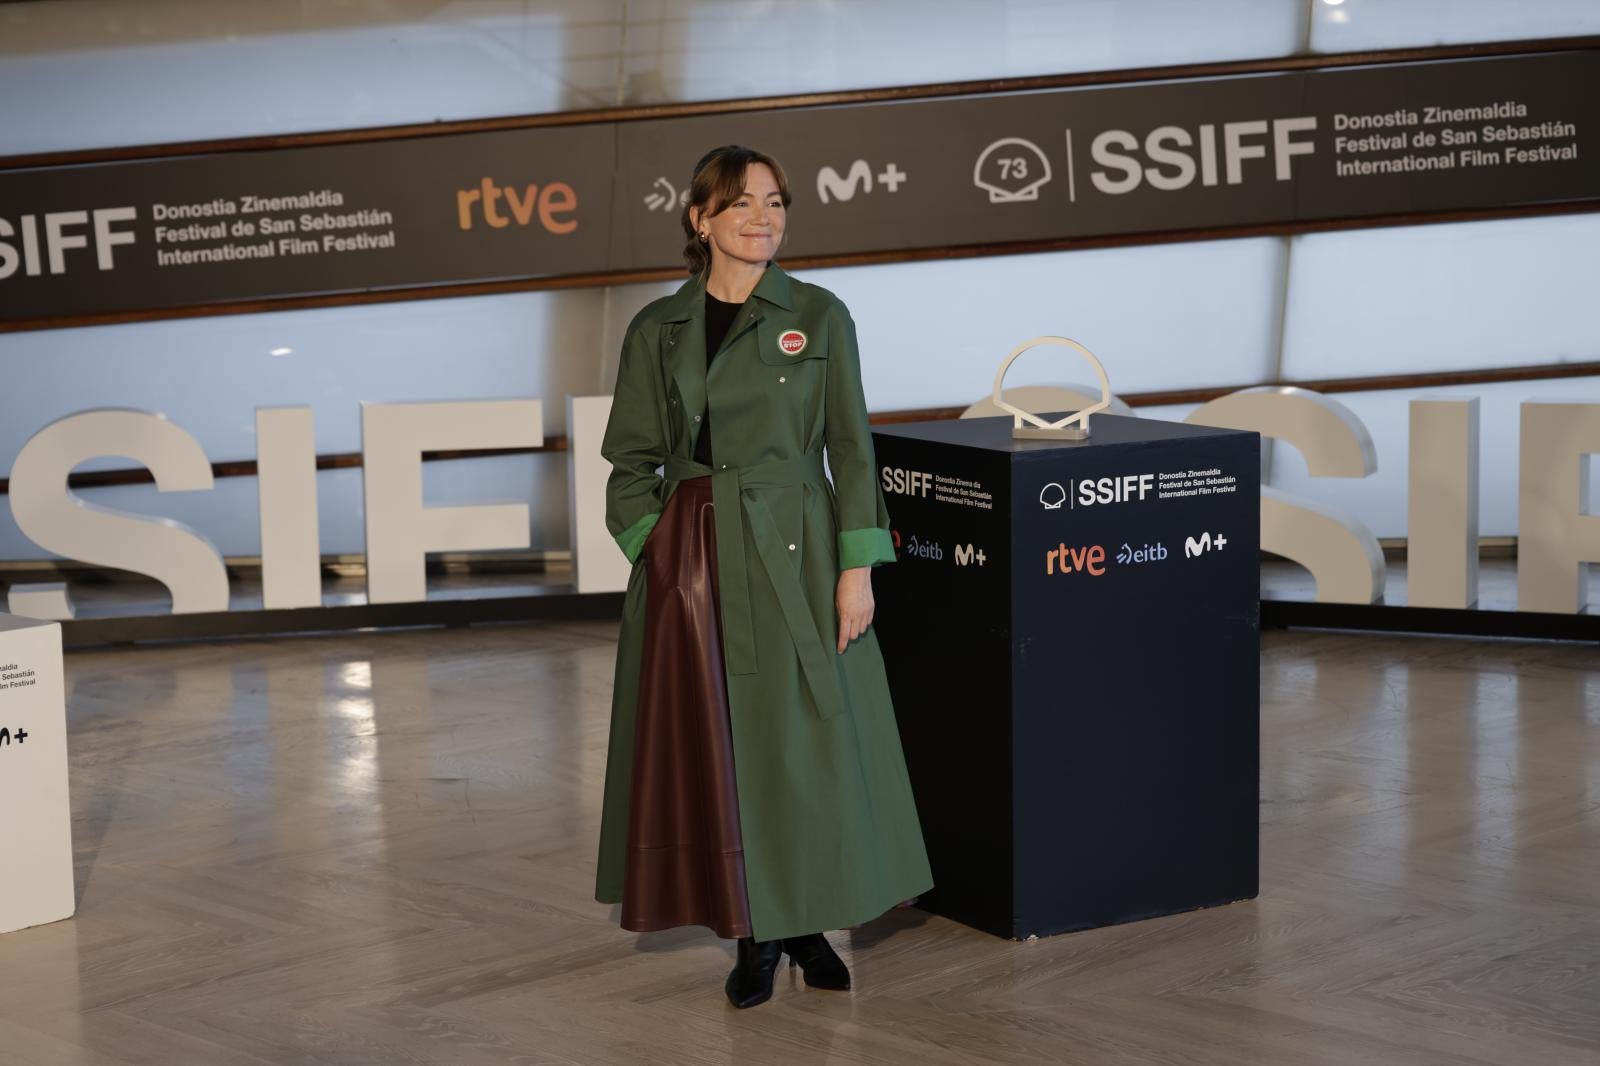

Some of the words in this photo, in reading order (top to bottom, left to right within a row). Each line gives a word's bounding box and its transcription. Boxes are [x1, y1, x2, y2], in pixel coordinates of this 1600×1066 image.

[1334, 110, 1418, 131] Donostia
[1423, 101, 1528, 124] Zinemaldia
[1335, 133, 1407, 153] Festival
[1412, 131, 1436, 148] de
[1441, 128, 1477, 146] San
[1483, 121, 1576, 142] Sebastián
[997, 158, 1028, 180] 73
[1090, 117, 1317, 195] SSIFF
[1336, 152, 1455, 176] International
[1460, 150, 1500, 167] Film
[1505, 143, 1577, 164] Festival
[153, 199, 236, 220] Donostia
[240, 190, 343, 213] Zinemaldia
[456, 177, 578, 235] rtve
[155, 222, 227, 243] Festival
[231, 220, 255, 237] de
[259, 218, 296, 235] San
[300, 209, 392, 231] Sebastián
[157, 241, 275, 265] International
[279, 238, 319, 256] Film
[323, 231, 395, 252] Festival
[881, 466, 933, 498] SSIFF
[935, 474, 955, 484] Donostia
[1159, 472, 1186, 480] Donostia
[1188, 468, 1221, 478] Zinemaldia
[1159, 481, 1183, 490] Festival
[1193, 479, 1205, 487] San
[1206, 476, 1236, 486] Sebastián
[935, 484, 952, 494] Festival
[935, 494, 963, 505] International
[964, 498, 974, 506] Film
[974, 500, 992, 510] Festival
[1078, 474, 1154, 506] SSIFF
[1159, 489, 1197, 499] International
[1198, 487, 1211, 495] Film
[1212, 485, 1236, 494] Festival
[919, 540, 943, 560] eitb
[1046, 542, 1105, 576] rtve
[1133, 542, 1168, 563] eitb
[2, 669, 35, 681] Sebastián
[10, 678, 36, 688] Festival
